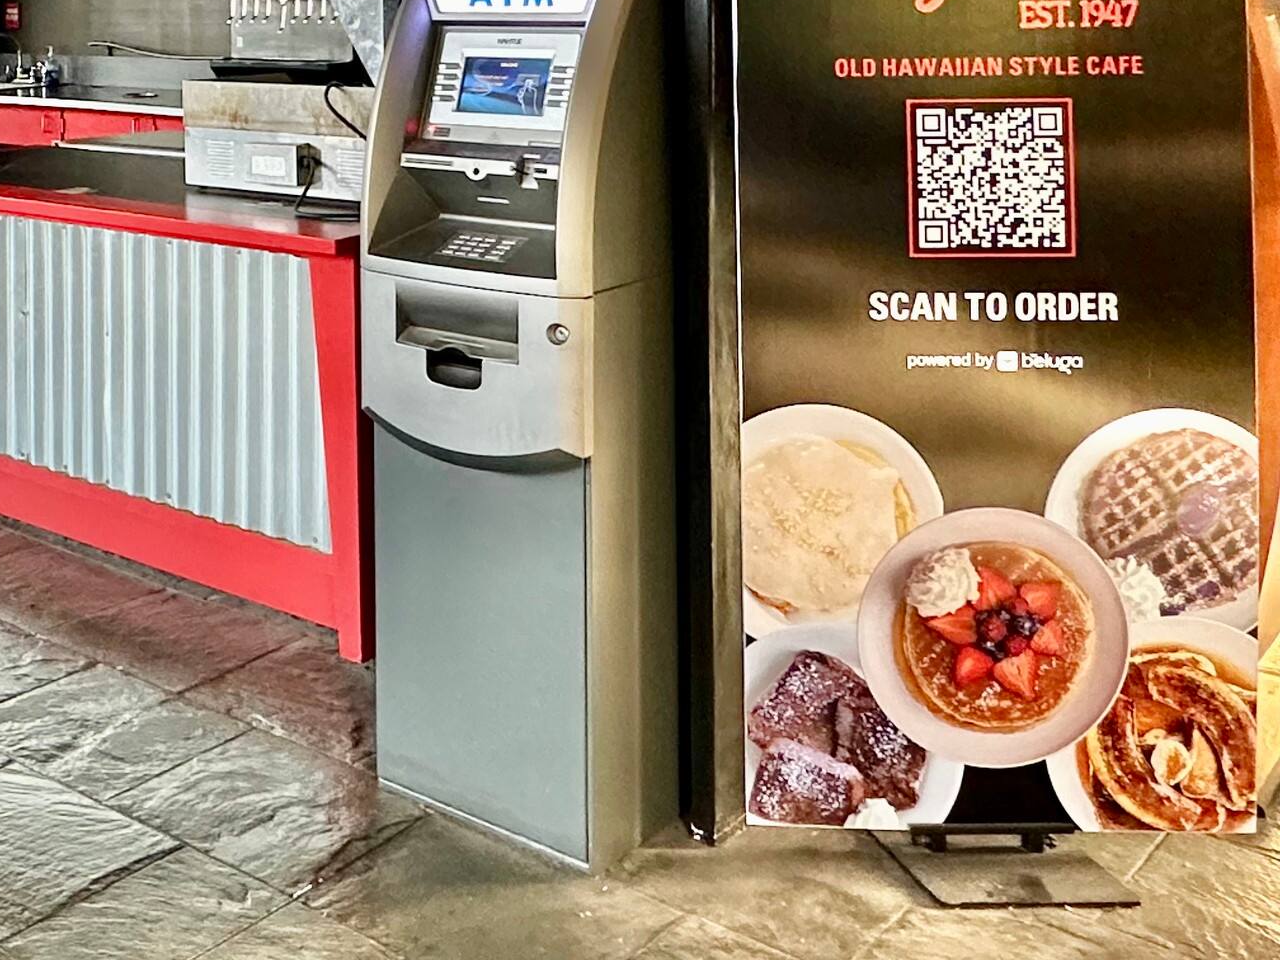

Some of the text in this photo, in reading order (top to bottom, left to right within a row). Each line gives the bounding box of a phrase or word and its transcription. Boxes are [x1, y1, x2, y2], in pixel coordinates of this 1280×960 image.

[1019, 0, 1075, 29] EST.
[835, 55, 1144, 77] OLD HAWAIIAN STYLE CAFE
[869, 292, 1119, 321] SCAN TO ORDER
[907, 352, 971, 370] powered
[975, 352, 995, 370] by
